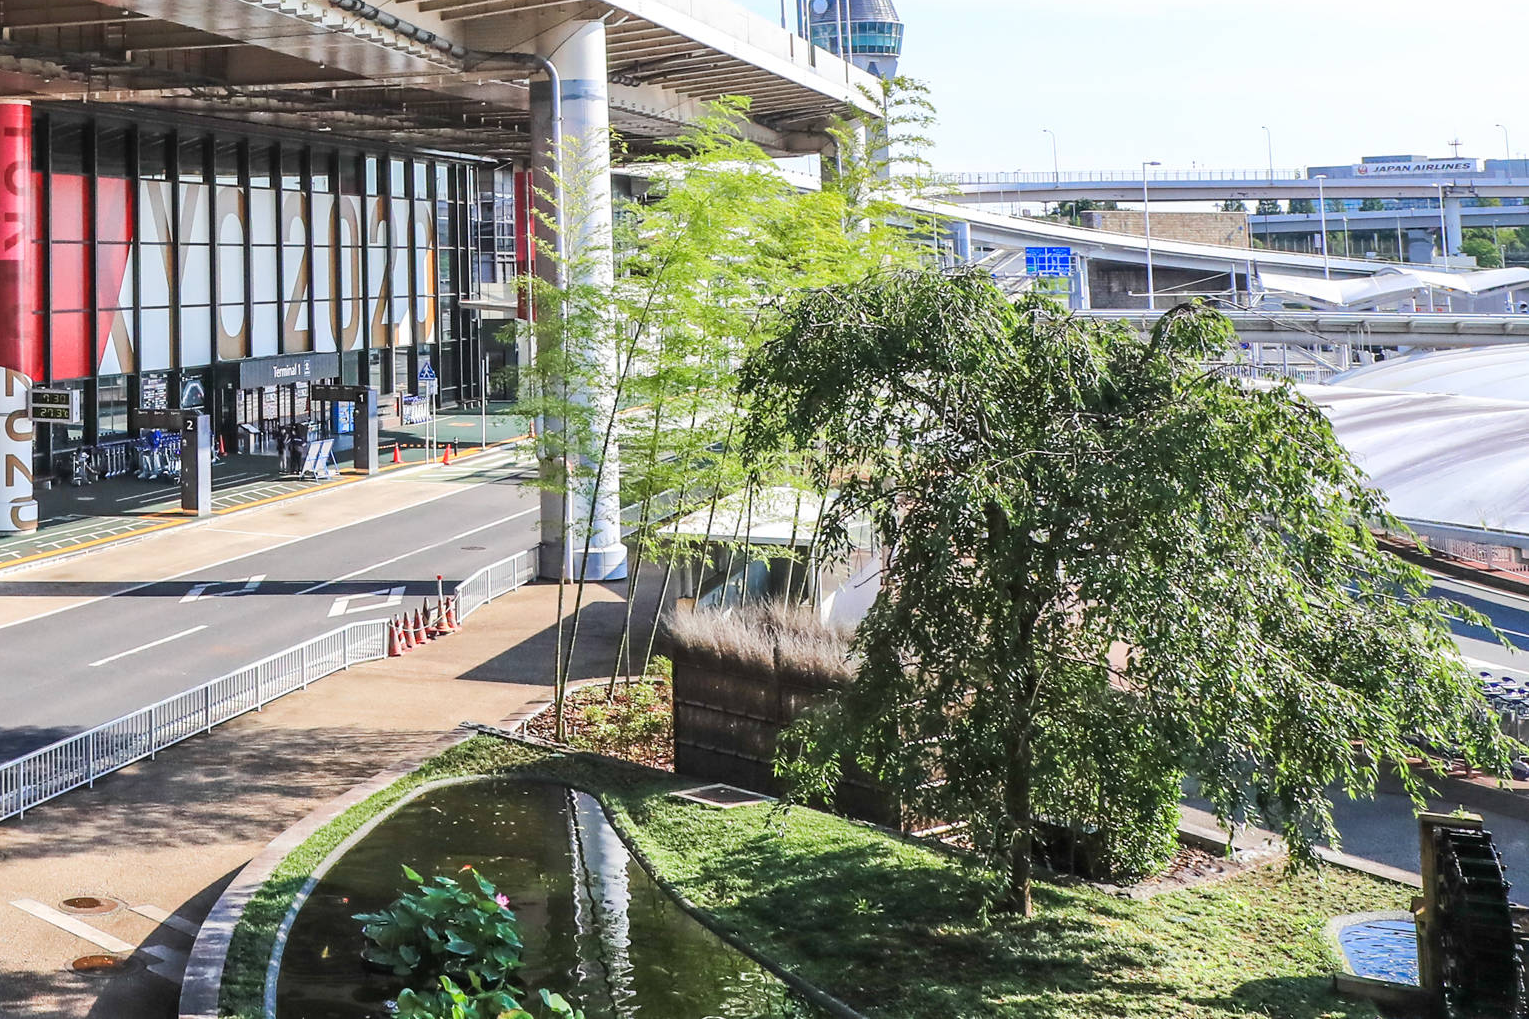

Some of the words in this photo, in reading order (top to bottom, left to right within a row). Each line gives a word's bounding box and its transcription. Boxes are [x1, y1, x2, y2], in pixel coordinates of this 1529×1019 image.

[1373, 165, 1411, 173] JAPAN
[1413, 162, 1471, 172] AIRLINES
[272, 362, 297, 379] Terminal
[358, 393, 364, 403] 1
[186, 420, 194, 430] 2
